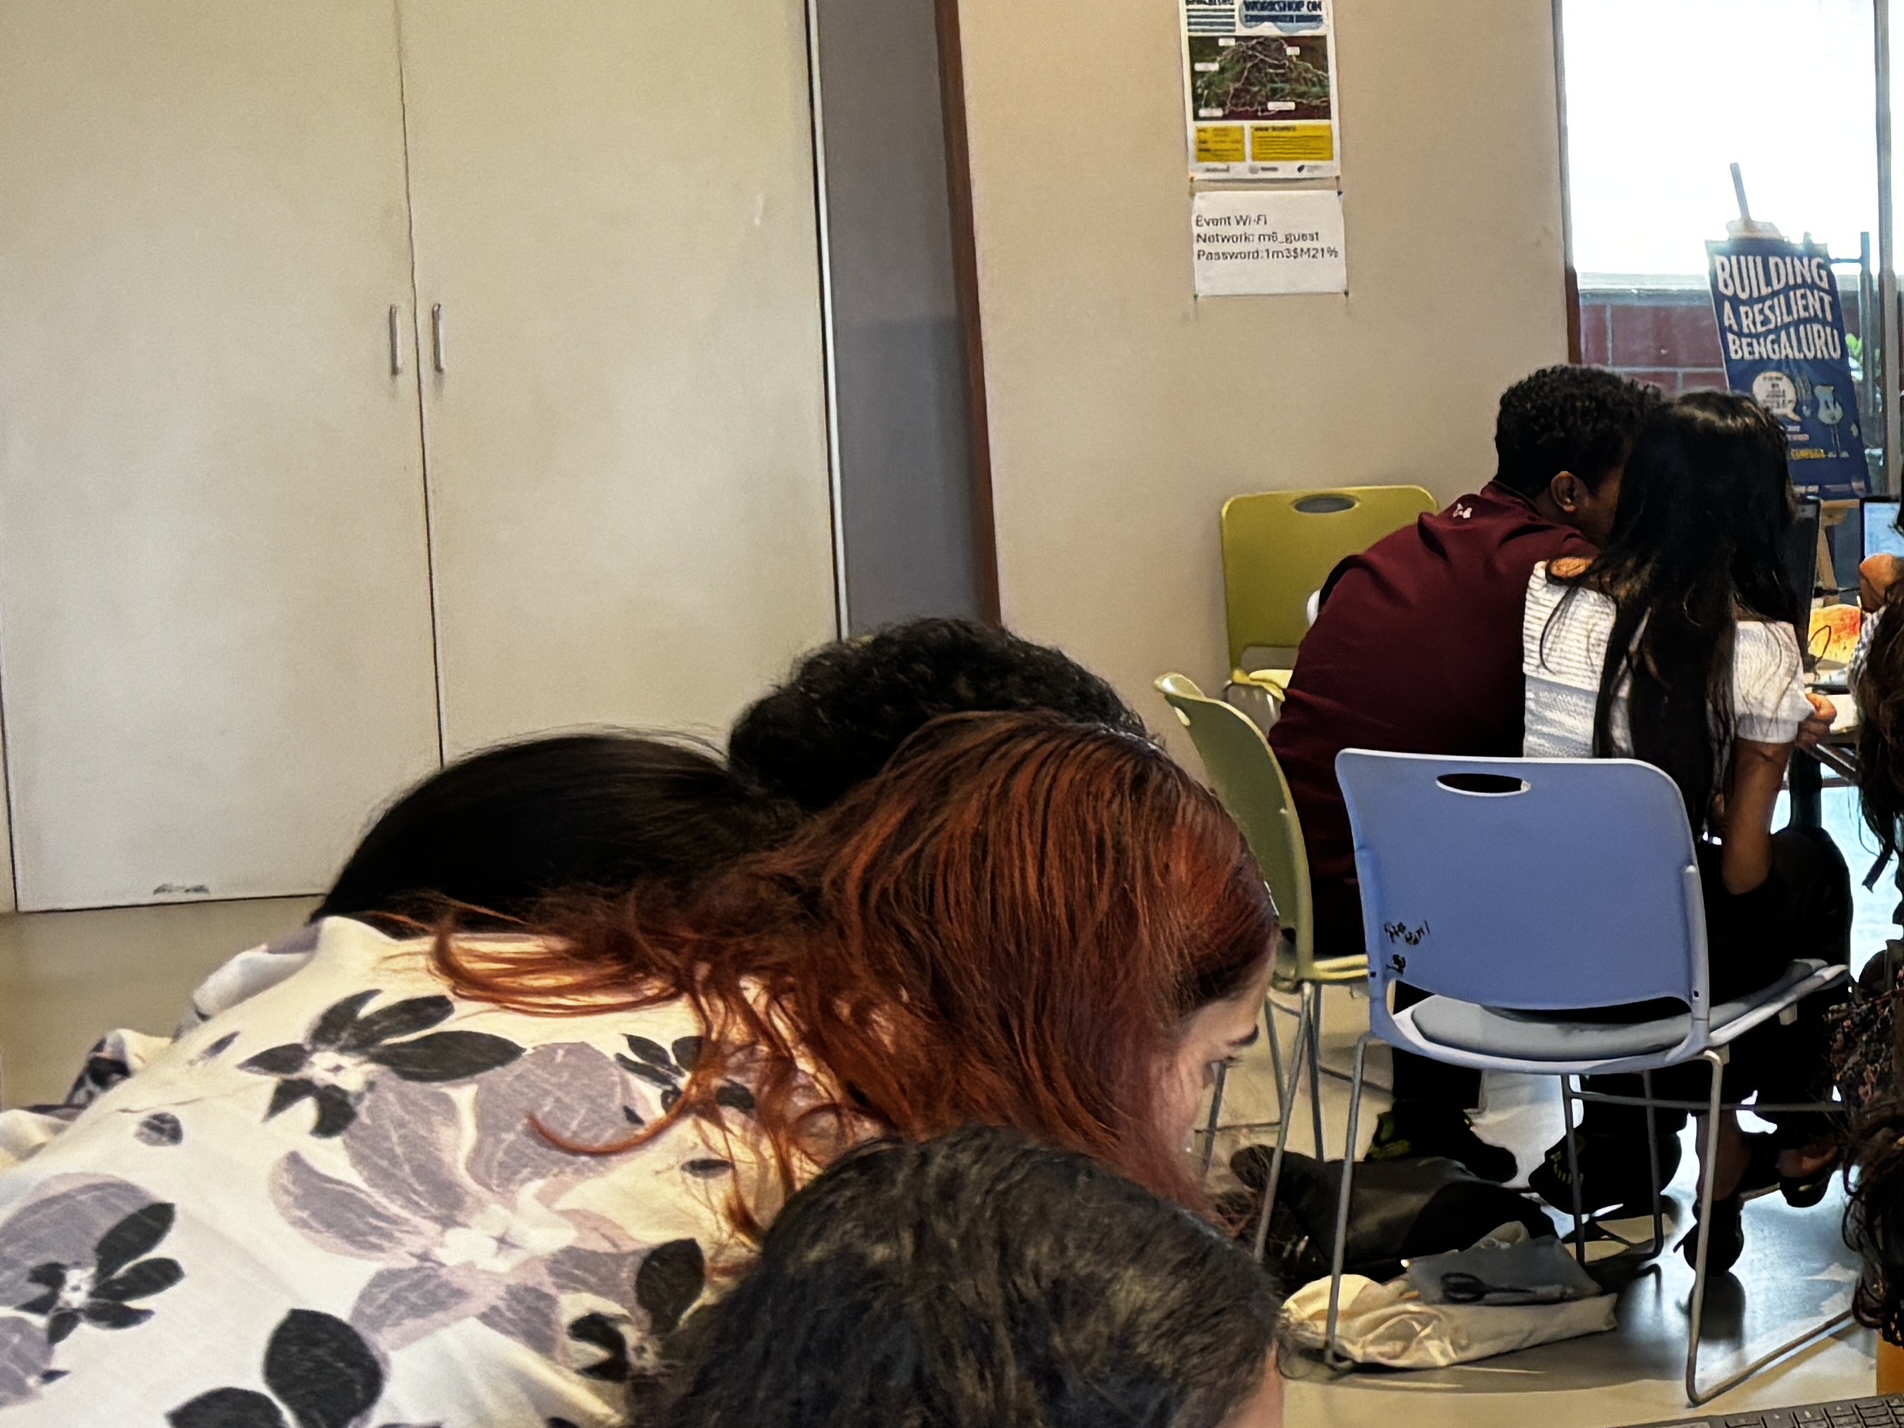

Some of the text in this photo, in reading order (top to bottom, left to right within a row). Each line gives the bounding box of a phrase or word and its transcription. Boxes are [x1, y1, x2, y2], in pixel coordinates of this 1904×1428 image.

[1195, 214, 1268, 227] Event Wi-Fi
[1196, 232, 1254, 244] Network:
[1715, 254, 1830, 301] BUILDING
[1723, 288, 1833, 335] A RESILIENT
[1727, 323, 1842, 361] BENGALURU
